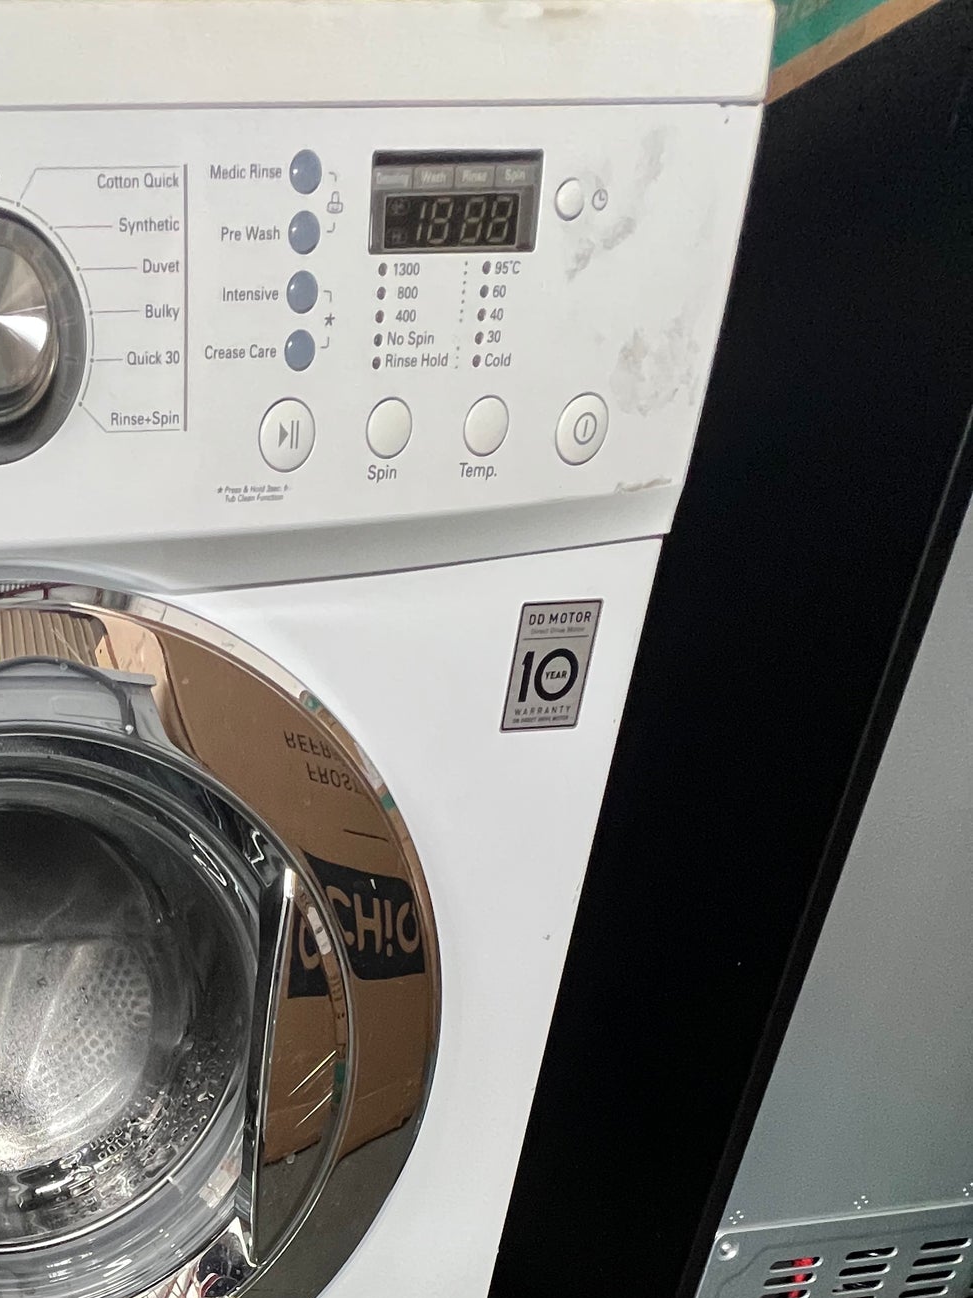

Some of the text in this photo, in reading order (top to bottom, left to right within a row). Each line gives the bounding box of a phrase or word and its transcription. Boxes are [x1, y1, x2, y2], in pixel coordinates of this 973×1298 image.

[210, 164, 282, 180] Medic Rinse
[504, 168, 526, 184] Spin
[97, 173, 180, 190] Cotton Quick
[118, 217, 180, 236] Synthetic
[221, 225, 280, 242] Pre Wash
[142, 258, 180, 274] Duvet
[393, 262, 420, 276] 1300
[222, 286, 279, 302] Intensive
[397, 286, 418, 300] 800
[492, 284, 507, 298] 60
[145, 304, 180, 321] Bulky
[395, 309, 417, 323] 400
[490, 308, 504, 321] 40
[387, 331, 435, 349] No Spin
[487, 330, 501, 344] 30
[127, 350, 180, 366] Quick 30
[204, 344, 277, 360] Crease Care
[385, 353, 449, 368] Rinse Hold
[484, 353, 512, 368] Cold
[110, 411, 180, 428] Rinse+Spin
[367, 465, 397, 484] Spin
[459, 462, 497, 480] Temp.
[529, 611, 592, 625] DD MOTOR
[518, 648, 579, 702] 10
[545, 670, 568, 680] YEAR
[514, 705, 572, 716] WARRANTY
